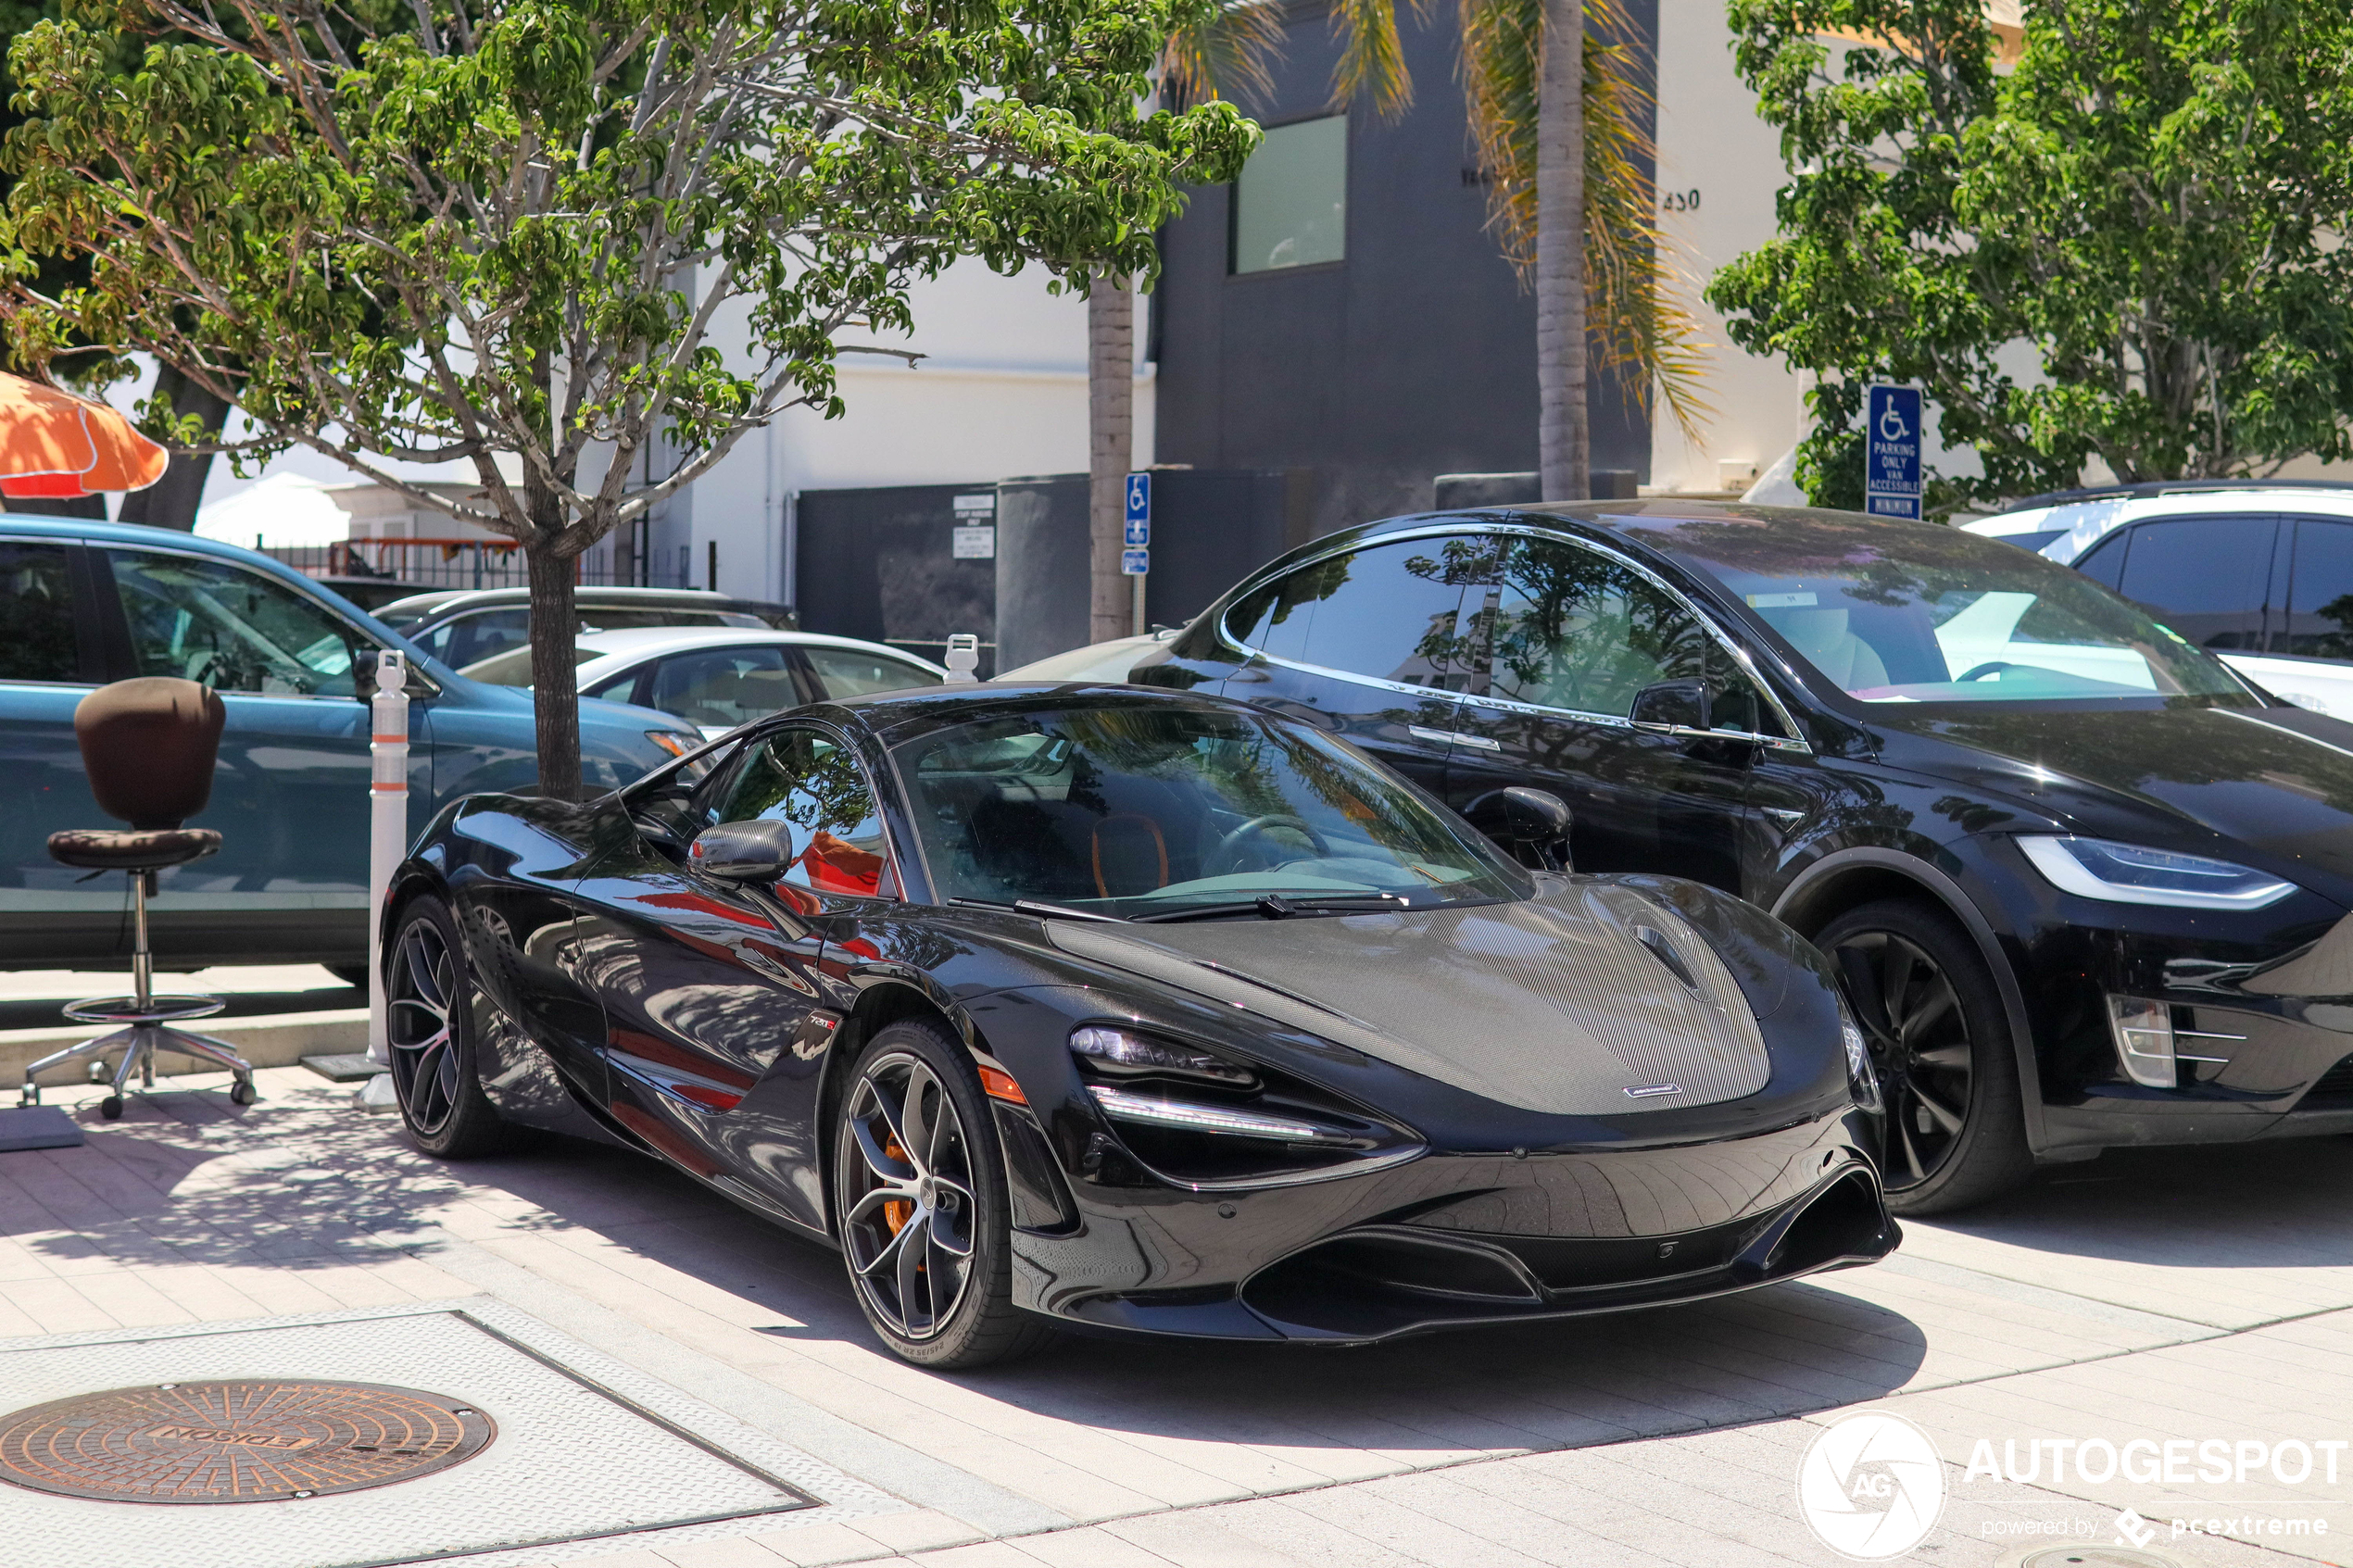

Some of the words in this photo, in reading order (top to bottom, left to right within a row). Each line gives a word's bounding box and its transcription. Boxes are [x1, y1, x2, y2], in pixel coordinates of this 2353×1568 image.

[1874, 442, 1916, 457] PARKING
[1881, 456, 1907, 469] ONLY
[1886, 470, 1904, 480] VAN
[1870, 479, 1919, 493] ACCESSIBLE
[1875, 498, 1913, 515] MINIMUM
[811, 1015, 836, 1030] 720S
[1633, 1085, 1671, 1095] McLaren
[916, 1340, 945, 1356] 245/35
[160, 1427, 302, 1447] EDISON
